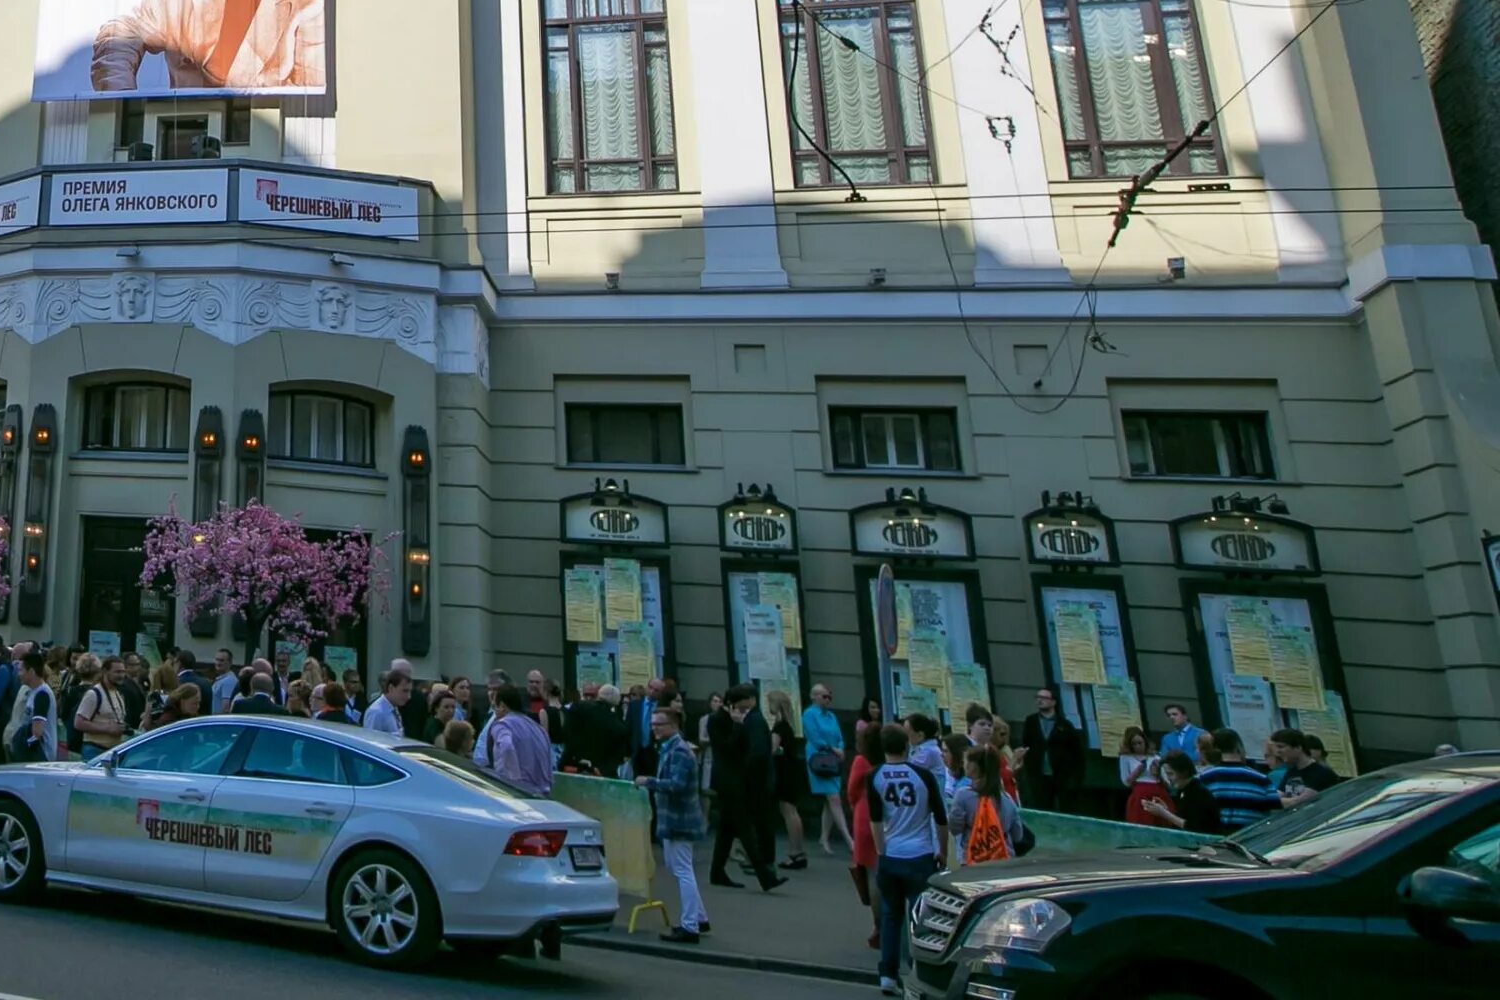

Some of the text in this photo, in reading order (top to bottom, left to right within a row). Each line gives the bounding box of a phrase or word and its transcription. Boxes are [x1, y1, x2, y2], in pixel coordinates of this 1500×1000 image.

[63, 180, 127, 195] ПРЕМИЯ
[62, 194, 218, 213] ОЛЕГА ЯНКОВСКОГО
[266, 193, 352, 219] ЧЕРЕШНЕВЫЙ
[357, 204, 382, 223] ЛЕС
[885, 782, 917, 807] 43
[145, 817, 240, 851] ЧЕРЕШНЕВЫЙ
[243, 830, 272, 855] ЛЕС
